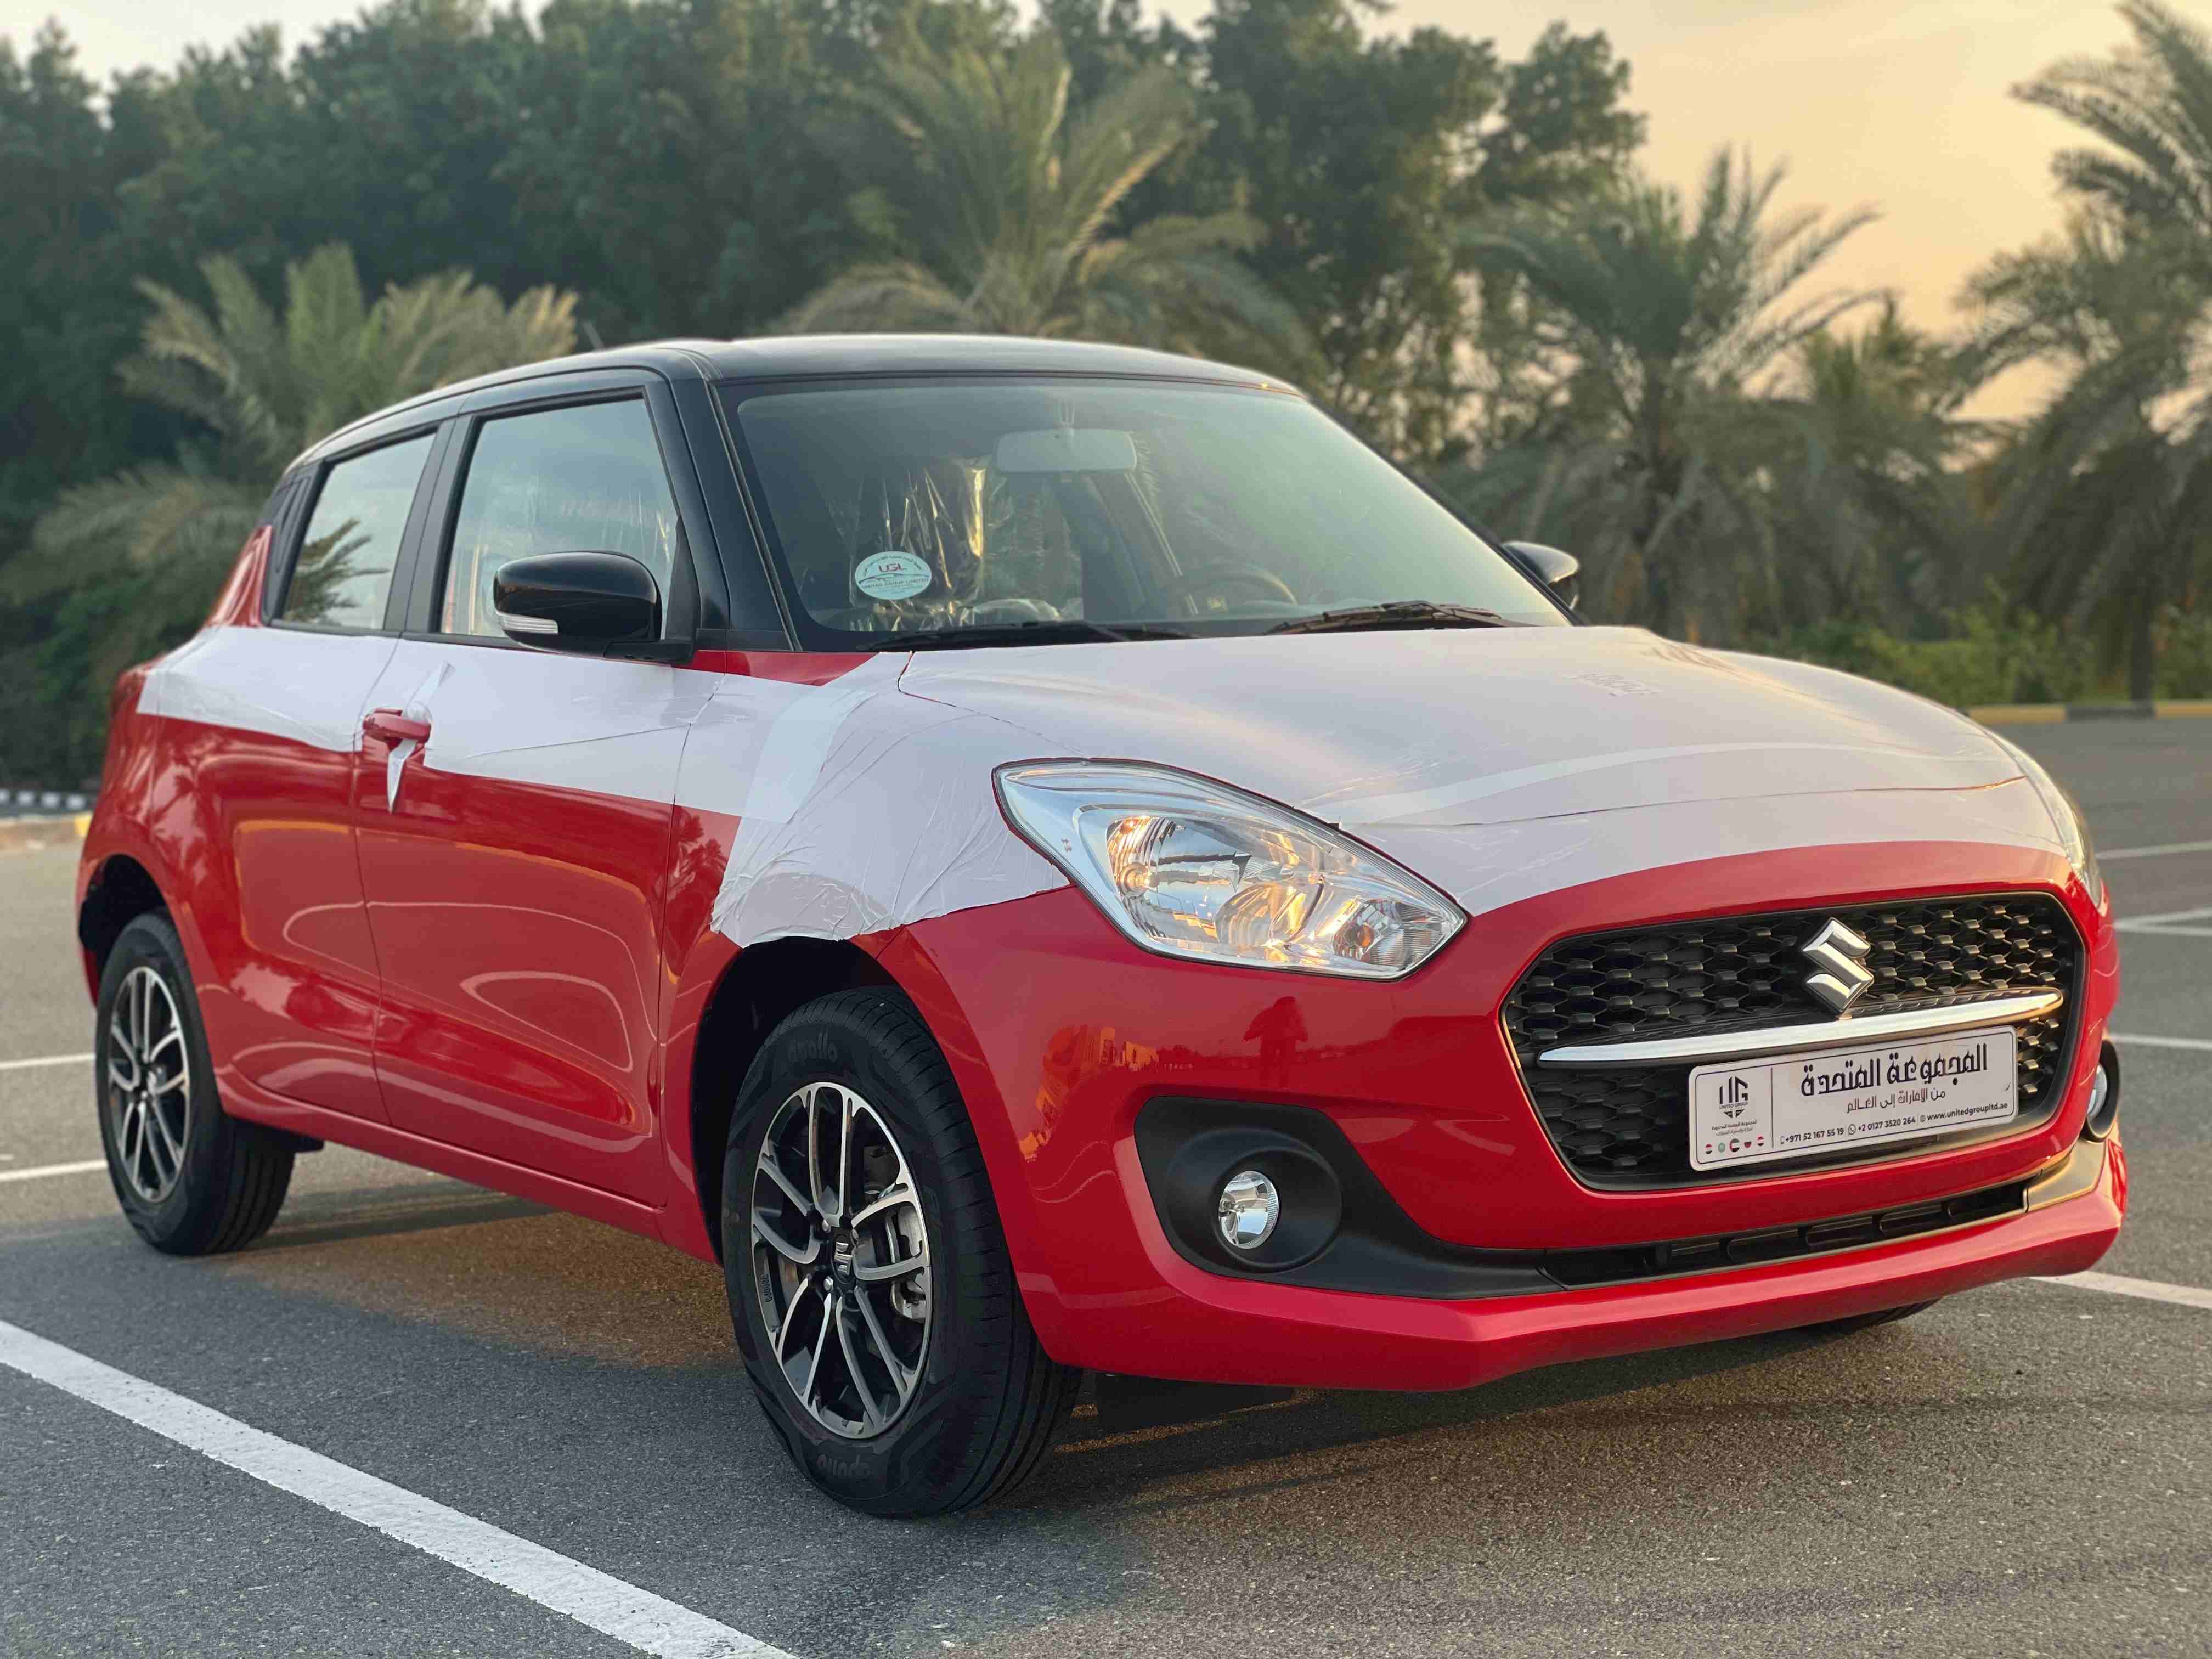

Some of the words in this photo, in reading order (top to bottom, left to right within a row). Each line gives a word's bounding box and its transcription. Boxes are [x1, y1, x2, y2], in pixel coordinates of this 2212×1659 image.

[879, 563, 907, 573] UGL
[1887, 1043, 1987, 1086] المجموعة
[1801, 1058, 1881, 1096] المتحدة
[1880, 1093, 1895, 1108] إلى
[1931, 1088, 1946, 1101] من
[1927, 1102, 2008, 1121] www.unitedgroupltd.ae
[1858, 1124, 1866, 1132] +2
[1867, 1121, 1883, 1131] 0127
[1885, 1119, 1901, 1128] 3520
[1903, 1116, 1916, 1125] 264
[1786, 1134, 1801, 1143] +971
[1803, 1132, 1812, 1141] 52
[1813, 1130, 1825, 1139] 167
[1827, 1128, 1835, 1137] 55
[1838, 1127, 1844, 1136] 19
